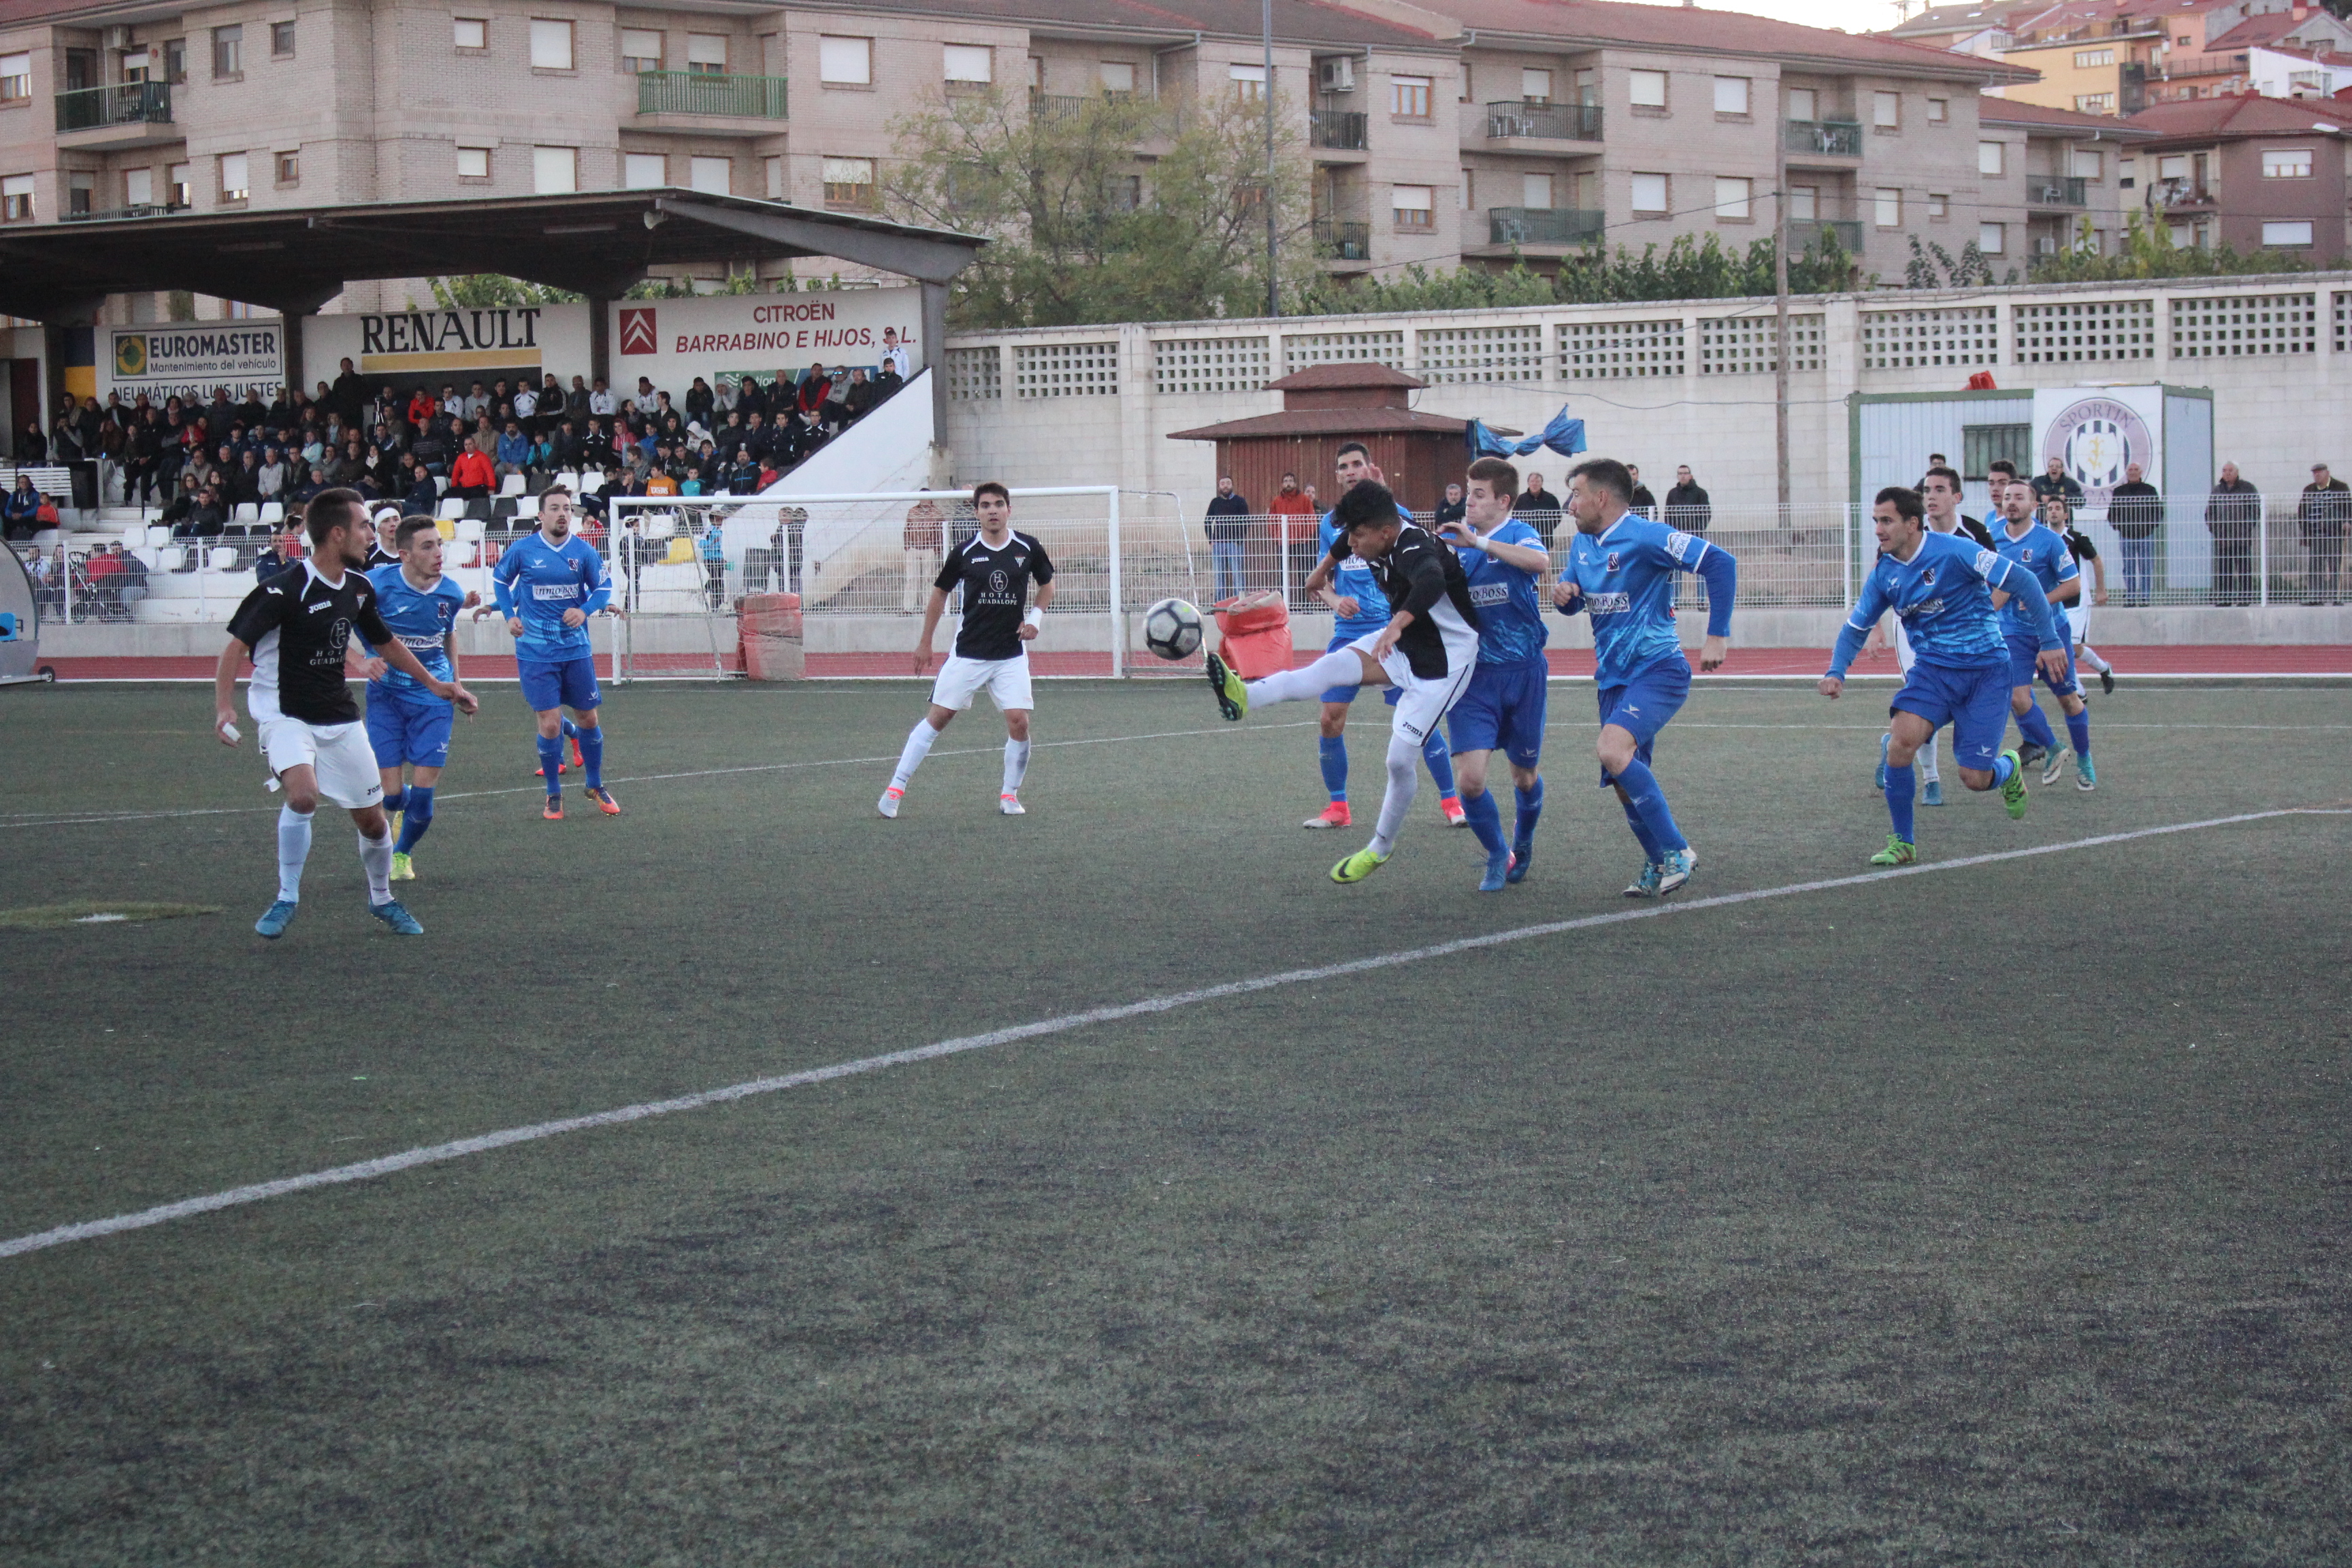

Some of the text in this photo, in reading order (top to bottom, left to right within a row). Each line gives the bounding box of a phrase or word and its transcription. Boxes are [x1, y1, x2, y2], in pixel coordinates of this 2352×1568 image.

[753, 300, 834, 323] CITROËN
[360, 308, 540, 353] RENAULT
[676, 331, 789, 353] BARRABINO
[796, 330, 808, 348] E
[815, 327, 876, 349] HIJOS,
[150, 332, 275, 358] EUROMASTER
[150, 358, 276, 373] Mantenimiento del vehículo
